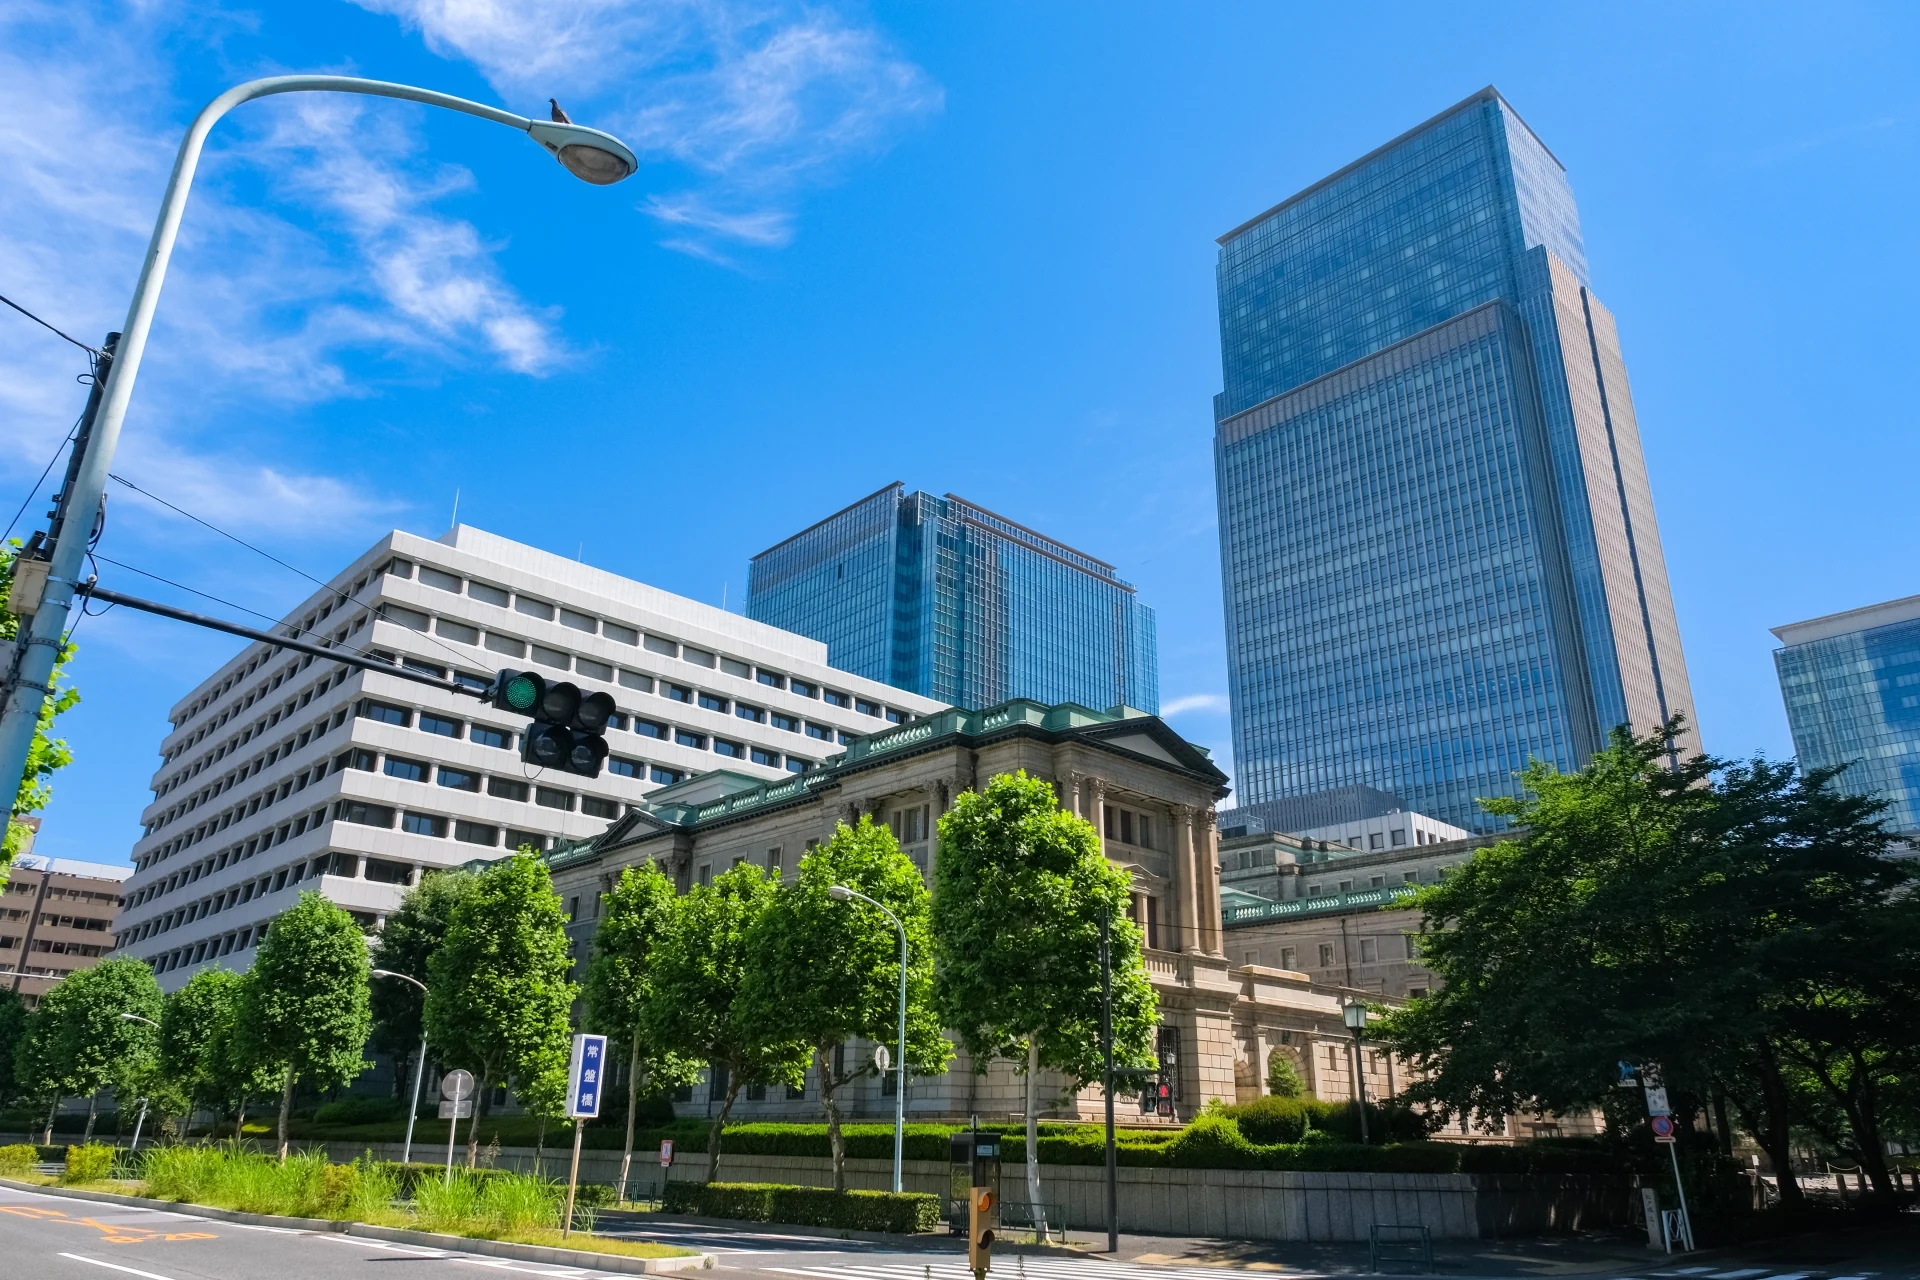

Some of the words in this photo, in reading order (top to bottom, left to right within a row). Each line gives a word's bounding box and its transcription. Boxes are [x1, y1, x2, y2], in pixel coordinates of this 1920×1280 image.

[581, 1045, 598, 1106] 常盤橋
[100, 1233, 218, 1243] 8-20
